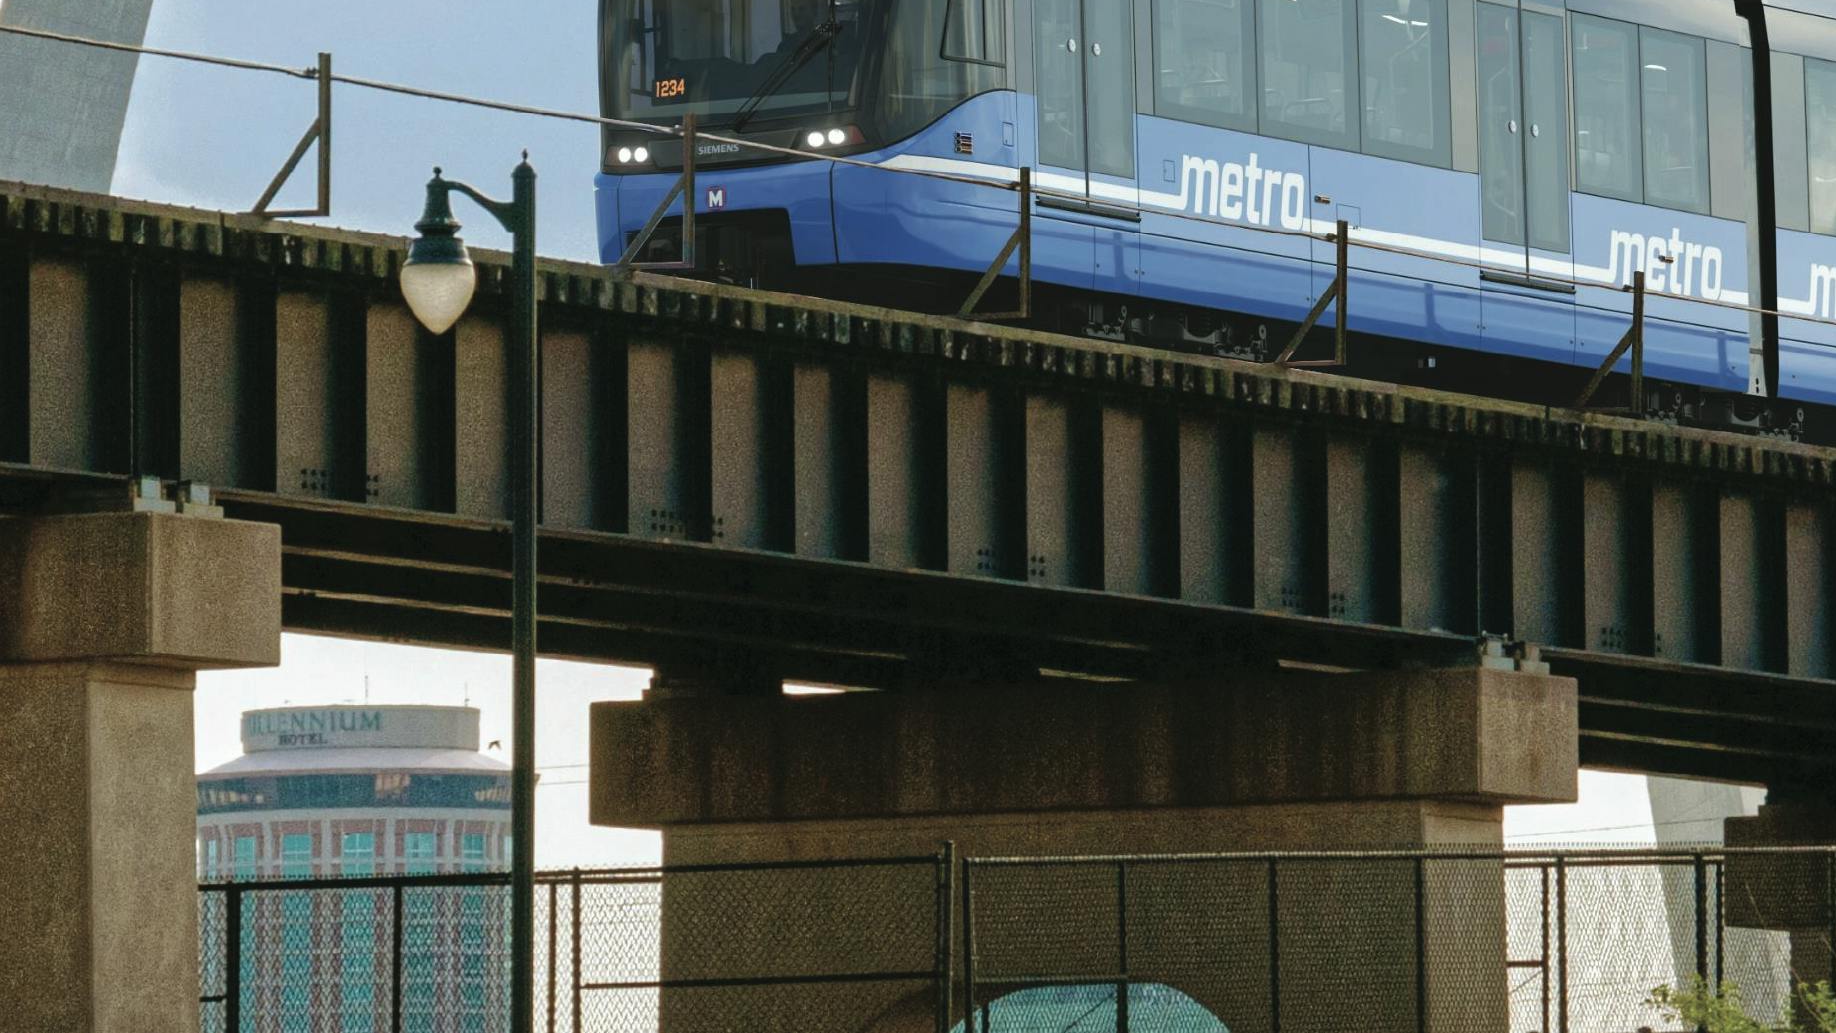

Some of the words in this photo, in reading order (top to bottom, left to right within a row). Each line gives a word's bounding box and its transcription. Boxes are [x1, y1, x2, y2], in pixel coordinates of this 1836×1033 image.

[656, 78, 685, 98] 1234
[698, 144, 740, 155] SIEMENS
[708, 189, 723, 208] M
[1179, 152, 1306, 231] metro
[1609, 227, 1723, 301] metro
[278, 733, 328, 745] HOTEL
